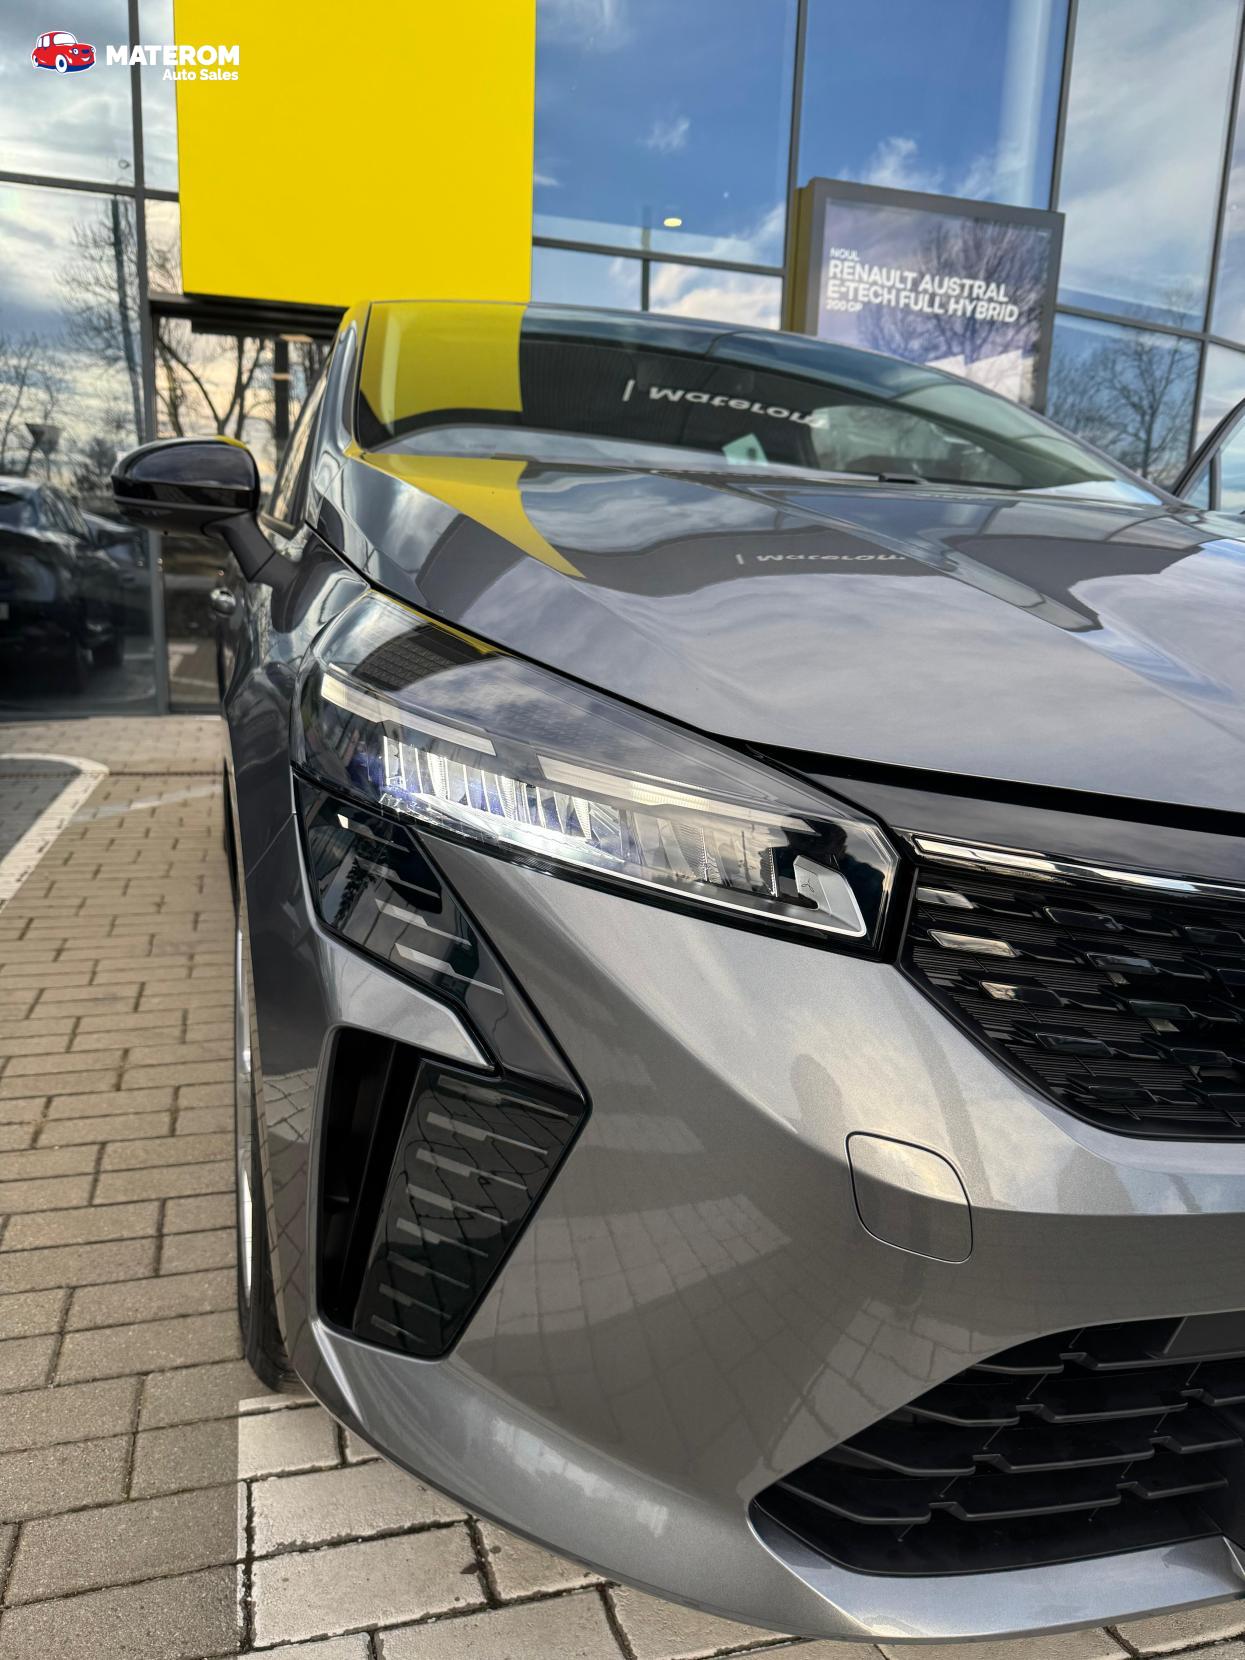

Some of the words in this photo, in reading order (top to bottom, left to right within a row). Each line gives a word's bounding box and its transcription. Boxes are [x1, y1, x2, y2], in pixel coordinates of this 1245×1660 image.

[829, 247, 860, 261] NOUL
[829, 260, 918, 290] RENAULT
[918, 274, 1010, 302] AUSTRAL
[825, 299, 847, 311] 200
[827, 280, 896, 308] E-TECH
[899, 291, 945, 314] FULL
[947, 298, 1019, 323] HYBRID
